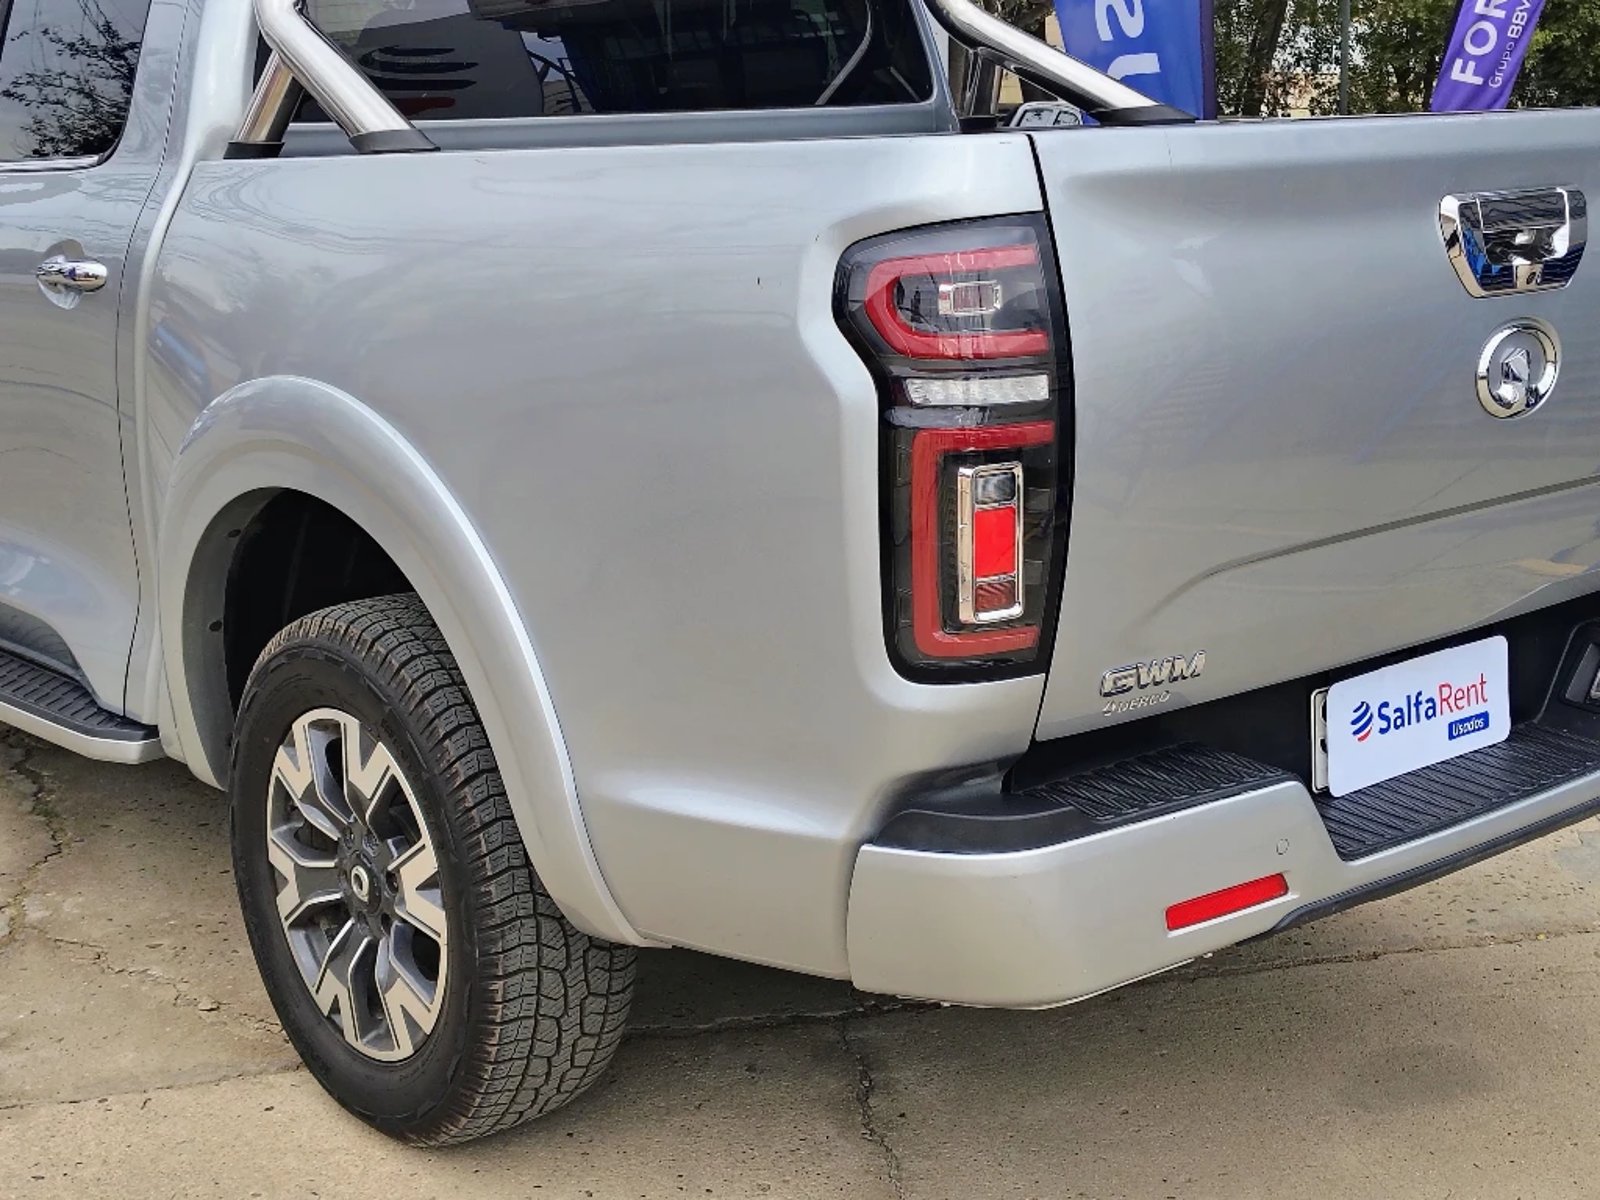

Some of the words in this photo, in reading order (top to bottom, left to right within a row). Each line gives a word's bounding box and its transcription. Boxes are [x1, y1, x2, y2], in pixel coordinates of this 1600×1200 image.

[1489, 41, 1515, 88] Grupo
[1100, 650, 1206, 697] GWM
[1377, 673, 1488, 735] SalfaRent
[1452, 717, 1484, 737] Usados
